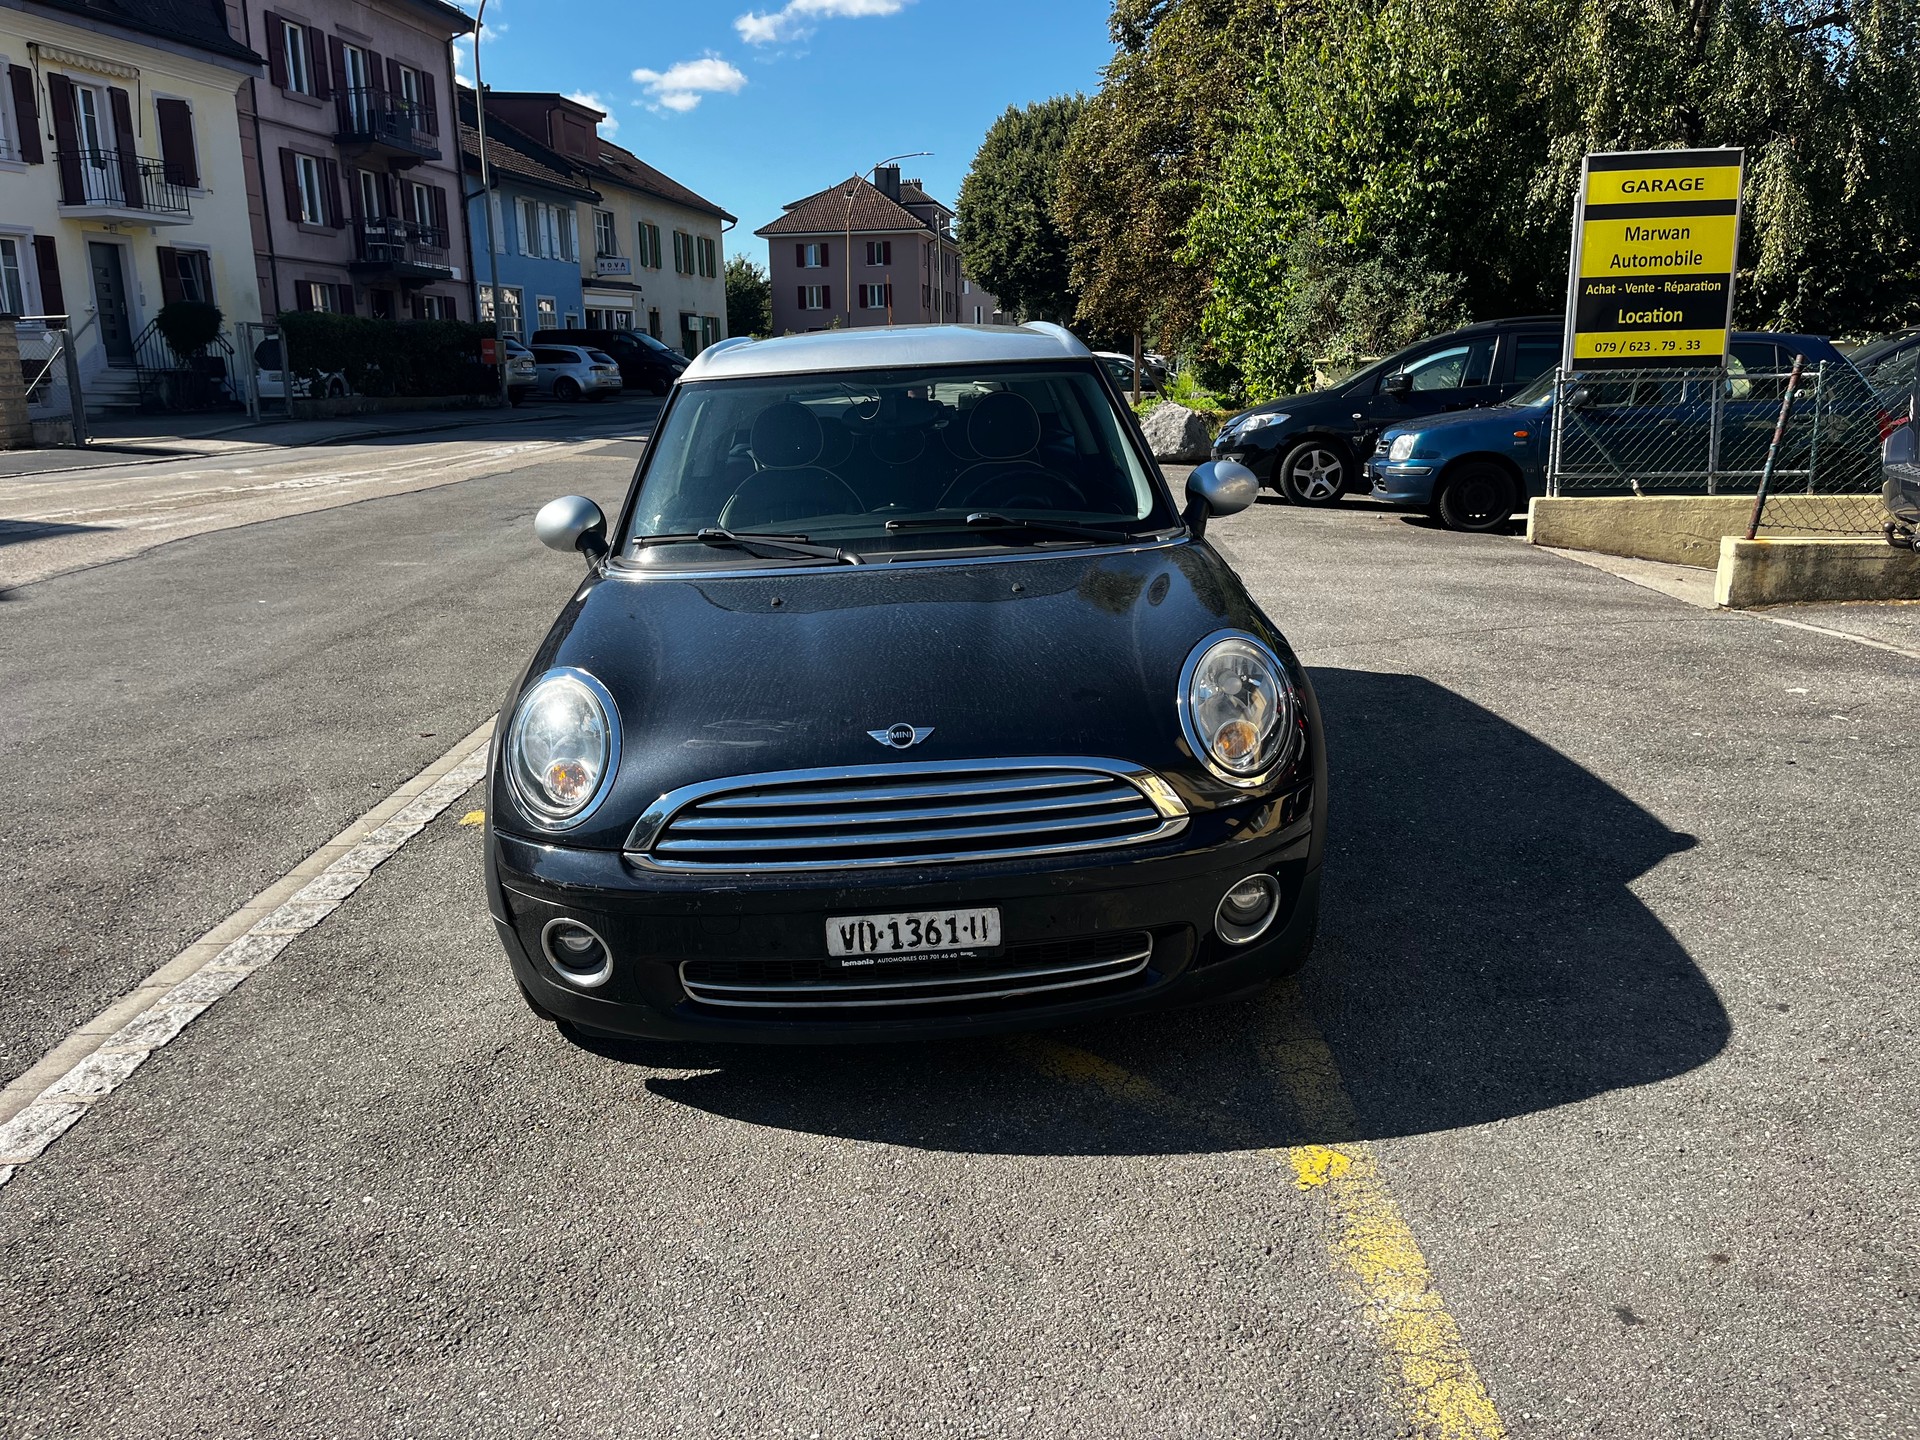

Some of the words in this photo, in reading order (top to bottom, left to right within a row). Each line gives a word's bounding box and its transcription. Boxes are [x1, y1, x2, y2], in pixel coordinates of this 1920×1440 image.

[1621, 178, 1704, 193] GARAGE
[1624, 226, 1691, 242] Marwan
[1609, 250, 1703, 269] Automobile
[1585, 283, 1616, 295] Achat
[1625, 282, 1655, 294] Vente
[1664, 281, 1721, 294] Réparation
[1618, 307, 1684, 324] Location
[1594, 341, 1617, 353] 079
[1619, 340, 1627, 354] /
[1629, 340, 1651, 352] 623
[1661, 340, 1676, 351] 79
[1686, 340, 1701, 351] 33
[891, 731, 912, 739] MINI
[877, 955, 917, 963] AUTOMOBILES
